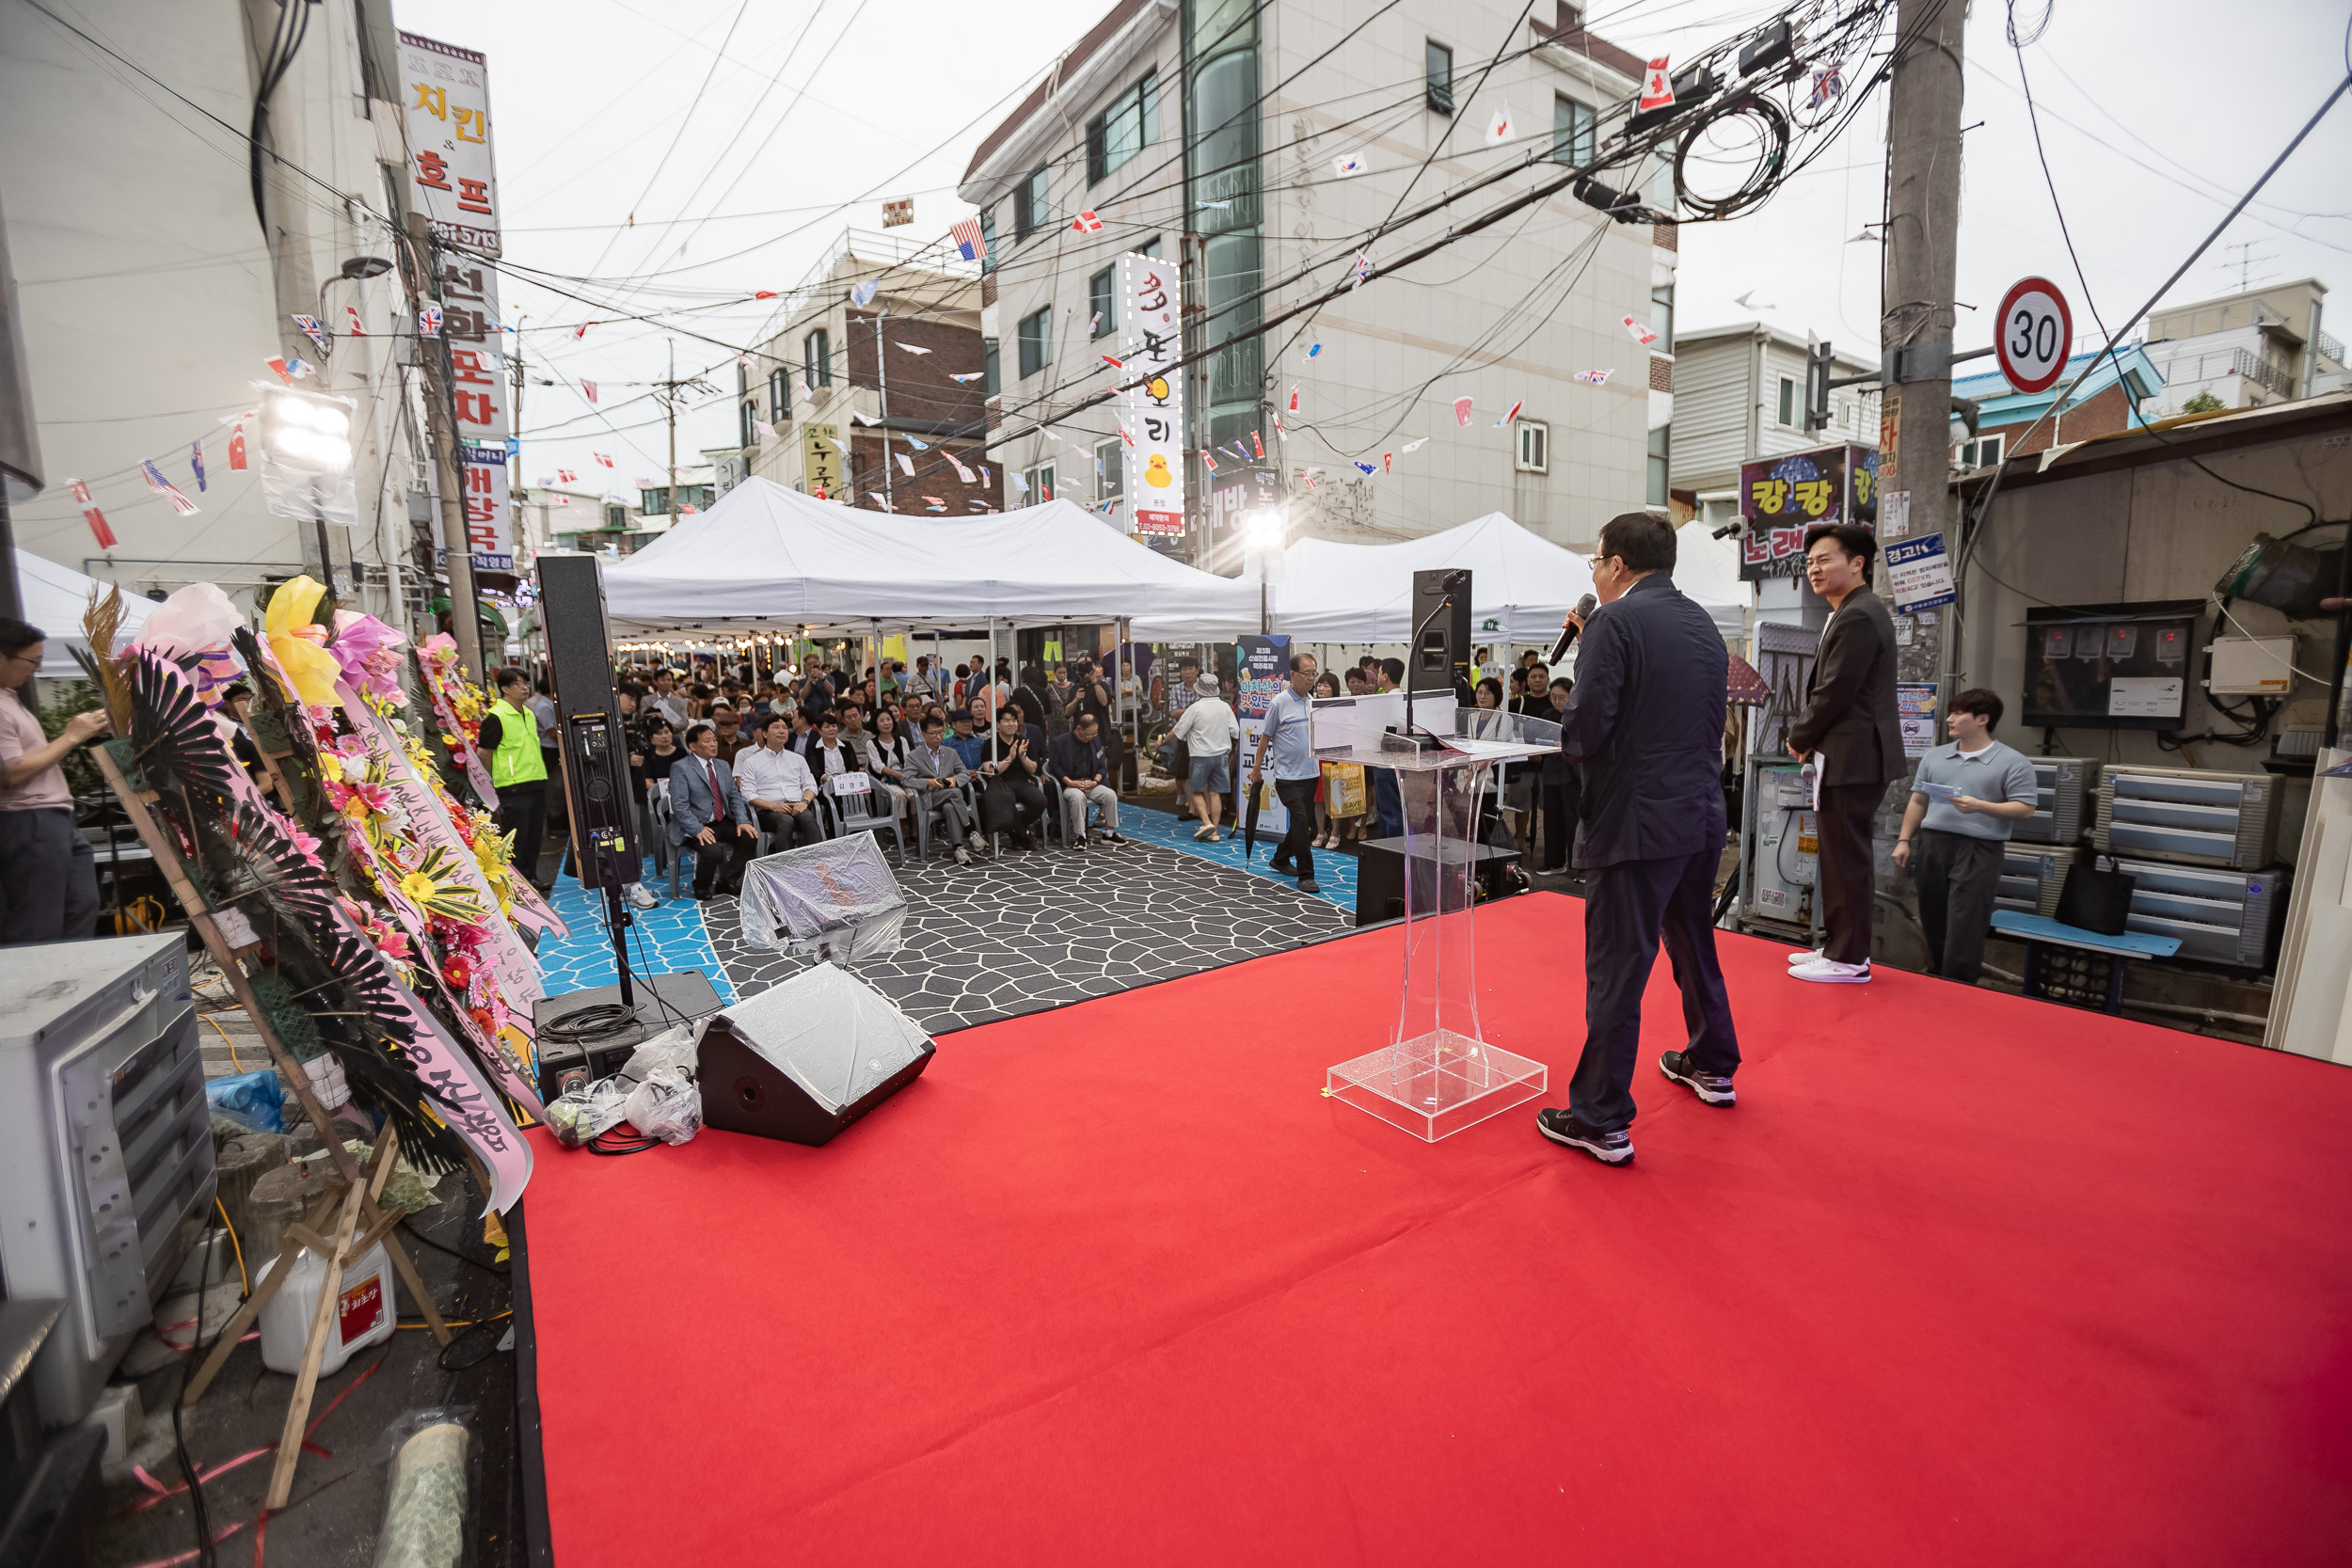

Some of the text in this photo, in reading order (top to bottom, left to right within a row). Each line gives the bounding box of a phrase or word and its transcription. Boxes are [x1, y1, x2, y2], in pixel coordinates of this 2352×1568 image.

[410, 82, 486, 144] 치킨
[443, 138, 456, 152] &
[415, 149, 493, 215] 호프
[2011, 309, 2057, 363] 30
[1752, 478, 1833, 516] 캉캉
[1745, 520, 1837, 564] 노래
[1888, 546, 1920, 563] 경고!
[1241, 678, 1282, 694] 아차산의
